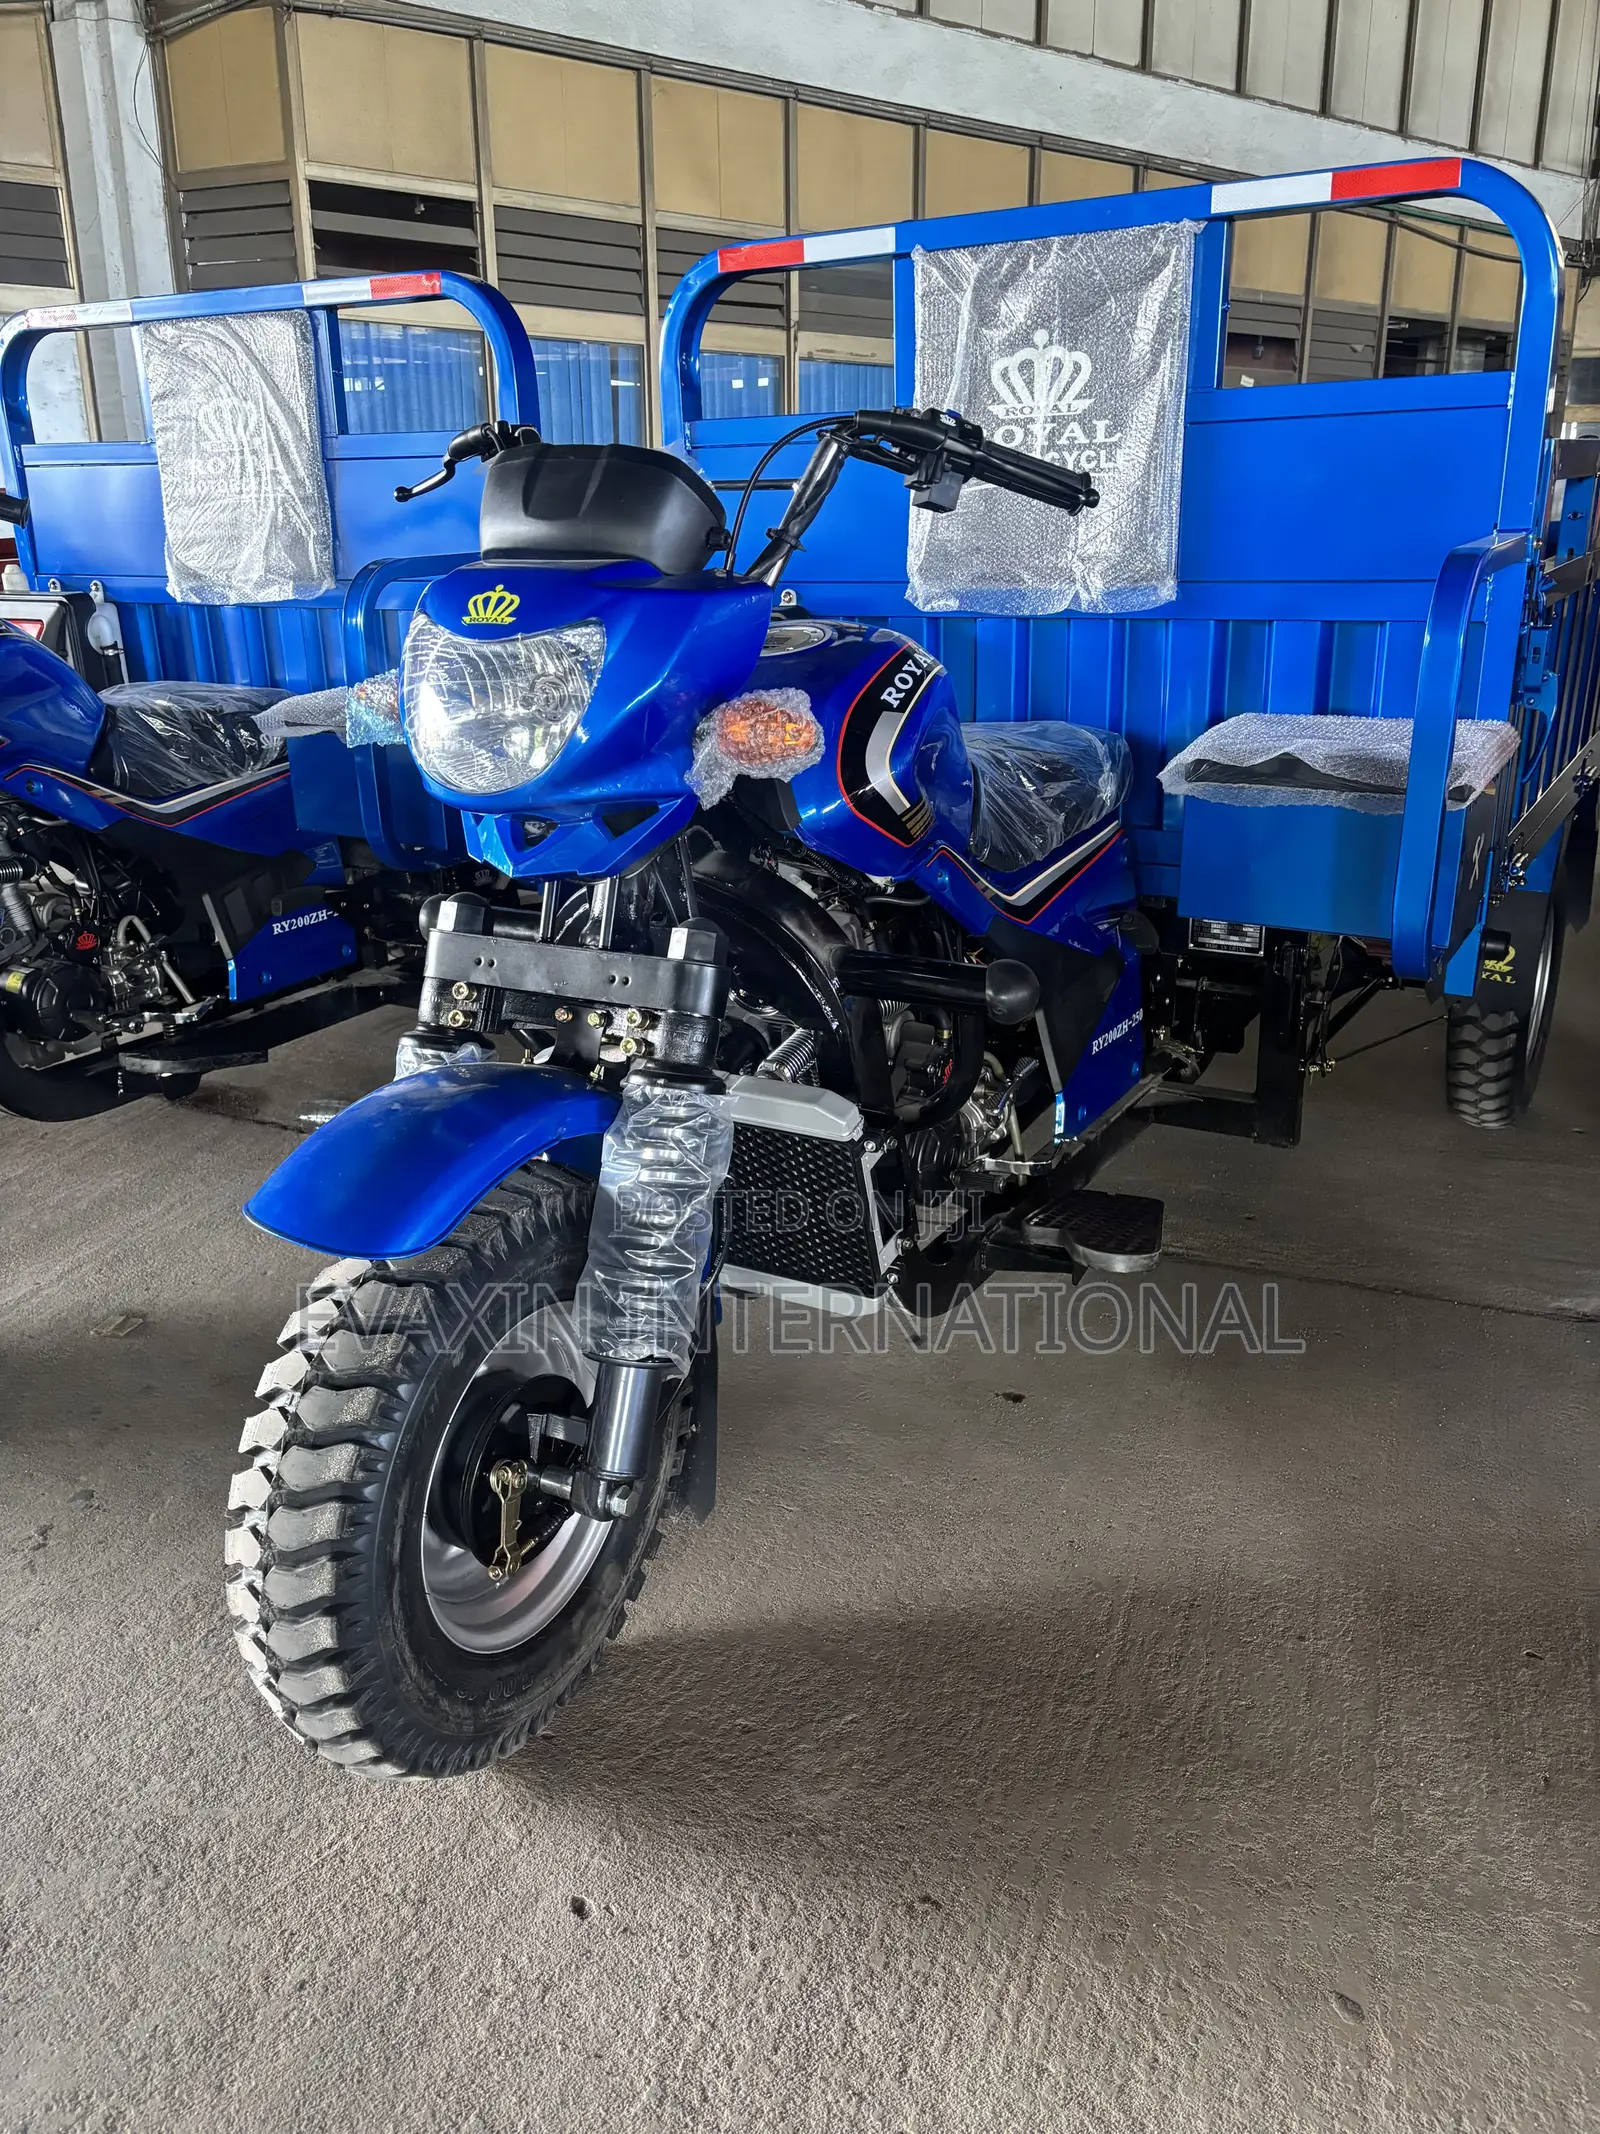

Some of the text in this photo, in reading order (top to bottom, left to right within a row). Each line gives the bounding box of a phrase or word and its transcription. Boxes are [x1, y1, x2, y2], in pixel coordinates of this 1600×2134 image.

[1004, 403, 1079, 416] ROAL
[983, 420, 1123, 448] OYAL
[1481, 971, 1516, 984] YAL
[1091, 1007, 1143, 1055] RY200ZH-250
